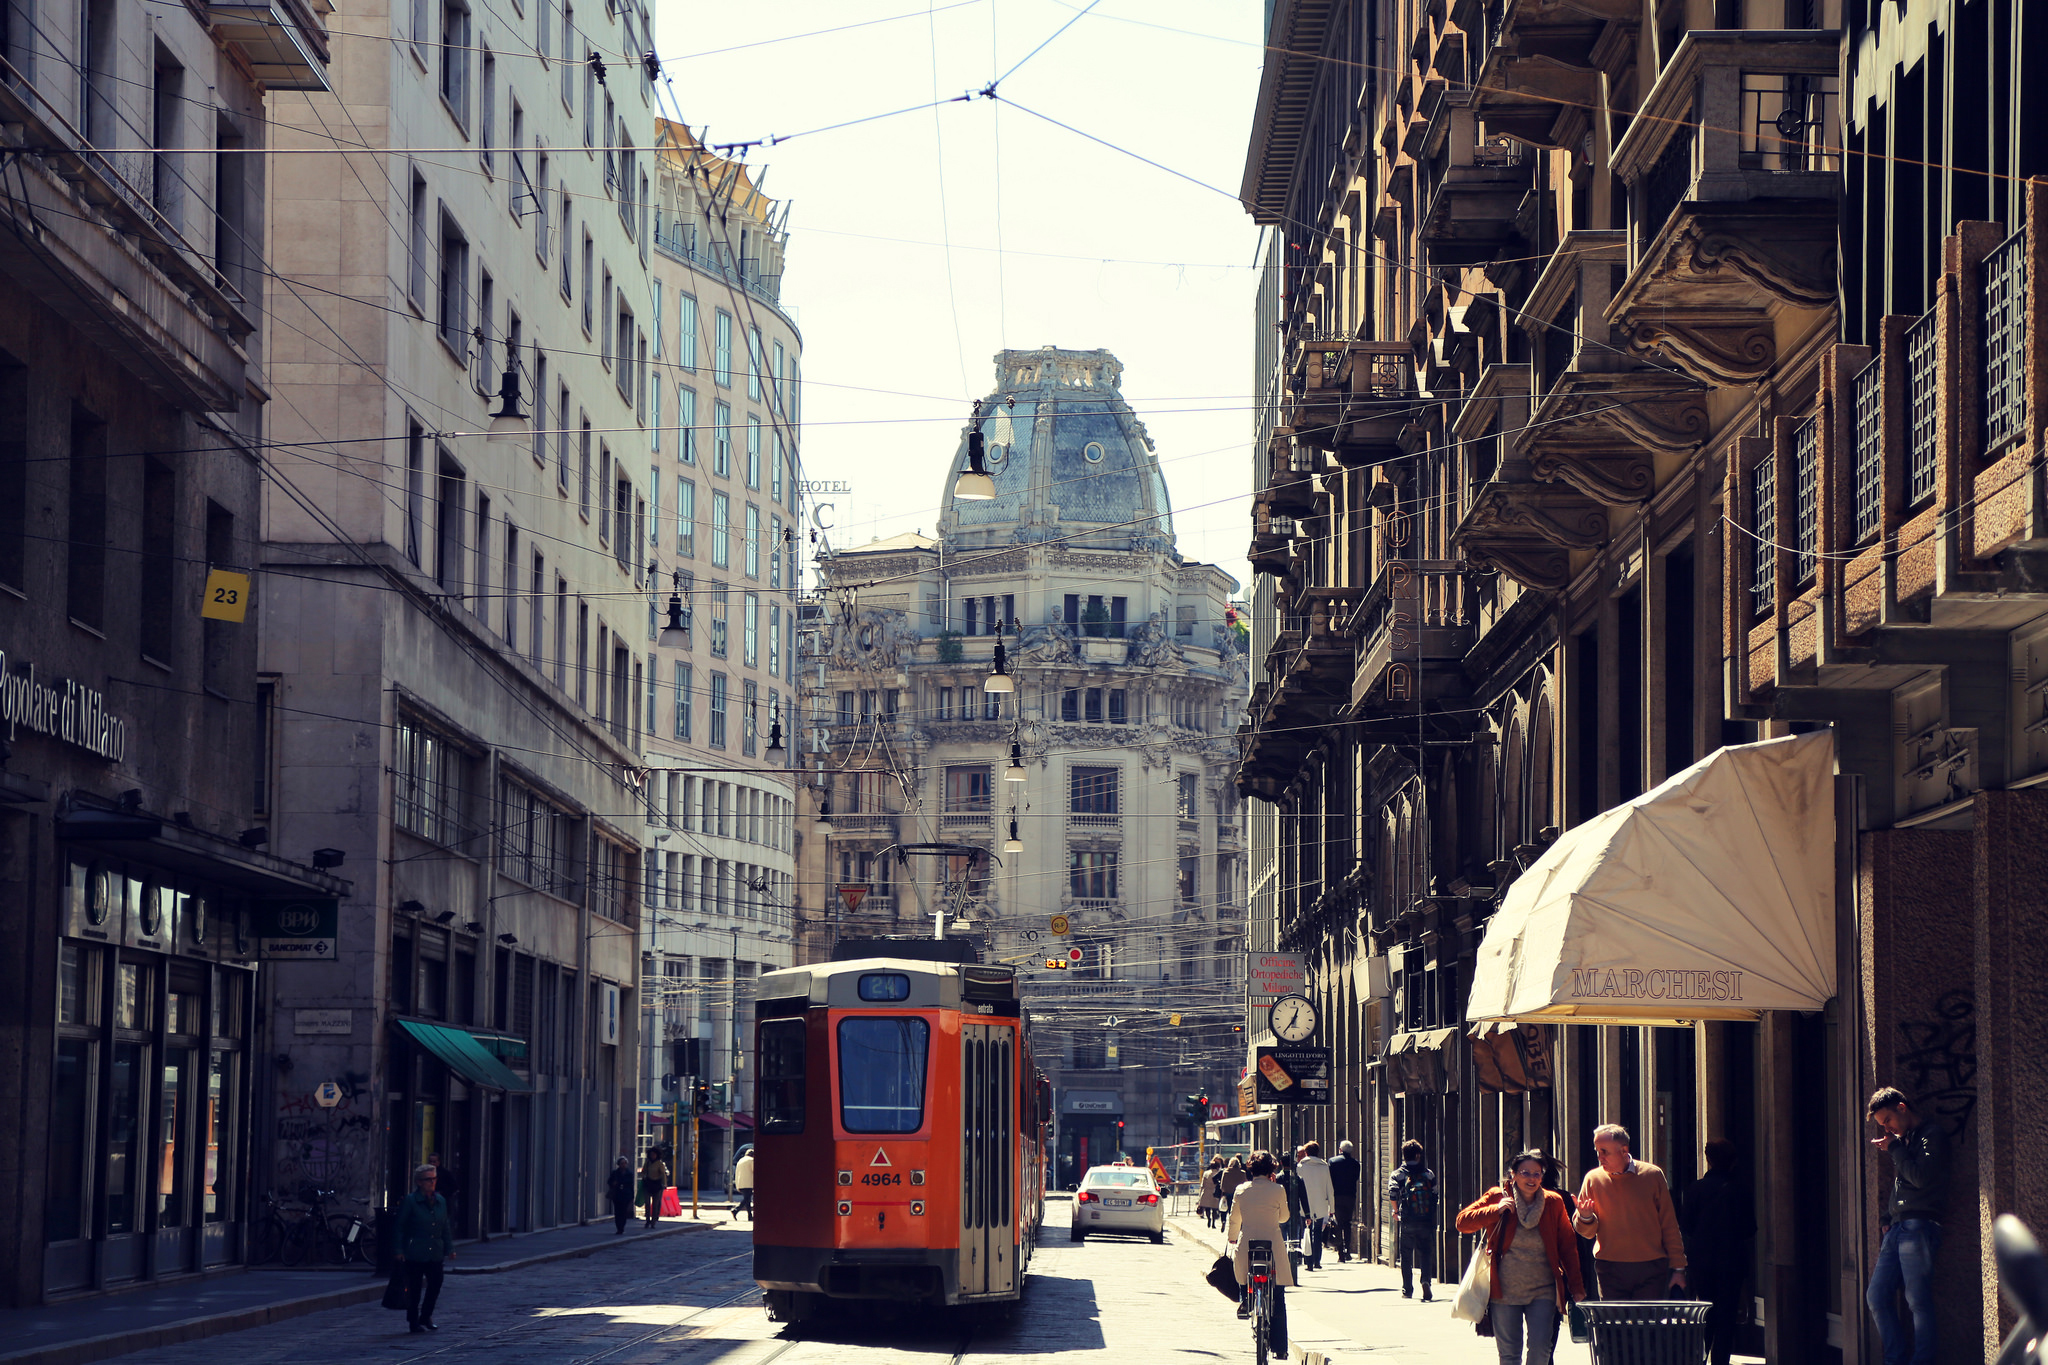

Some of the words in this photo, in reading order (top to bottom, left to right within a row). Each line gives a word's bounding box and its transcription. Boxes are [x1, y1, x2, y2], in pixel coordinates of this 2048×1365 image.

[799, 480, 852, 492] HOTEL
[213, 588, 238, 606] 23
[1385, 510, 1412, 701] ORSA
[808, 502, 837, 787] CAVALIERI
[61, 678, 75, 743] di
[78, 684, 125, 762] Milano
[281, 911, 317, 928] BPM
[268, 943, 313, 952] BANCOMAT
[1260, 956, 1296, 968] Officine
[1251, 968, 1304, 982] Ortopediche
[871, 976, 895, 994] 24
[1262, 982, 1294, 993] Milano
[1571, 968, 1744, 1001] MARCHESI
[977, 1003, 994, 1014] entrata
[1212, 1107, 1226, 1117] M
[861, 1173, 902, 1187] 4964
